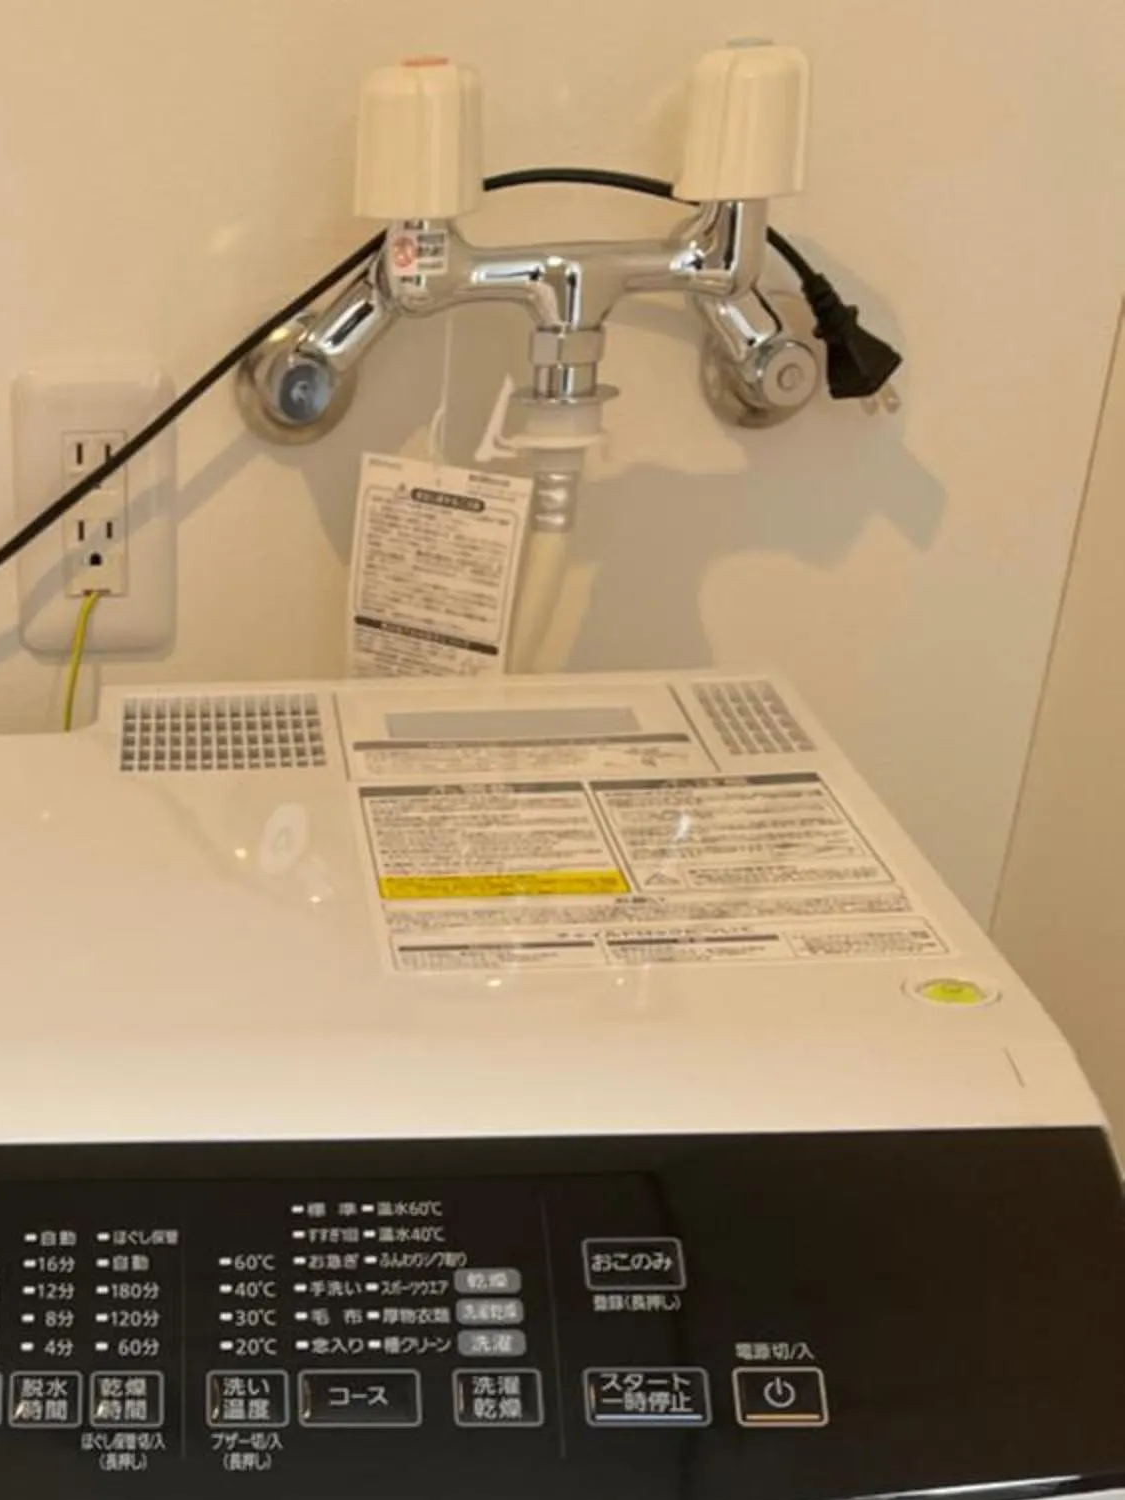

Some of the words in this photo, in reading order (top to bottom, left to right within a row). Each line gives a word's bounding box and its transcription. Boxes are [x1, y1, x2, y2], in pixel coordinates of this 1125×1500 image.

[38, 1257, 76, 1274] 16分
[590, 1252, 674, 1273] おこのみ
[38, 1284, 75, 1301] 12分
[111, 1283, 160, 1300] 180分
[310, 1279, 362, 1297] 手洗い
[44, 1310, 75, 1328] 8分
[111, 1310, 160, 1328] 120分
[43, 1339, 74, 1357] 4分
[117, 1339, 160, 1356] 60分
[22, 1377, 68, 1398] 脱水
[99, 1377, 147, 1398] 乾燥
[223, 1376, 271, 1397] 洗い
[472, 1375, 522, 1397] 洗濯
[600, 1372, 693, 1393] スタート
[328, 1385, 389, 1407] コース
[601, 1391, 694, 1414] 一時停止
[20, 1400, 68, 1421] 時間
[100, 1400, 147, 1421] 時間
[222, 1398, 271, 1421] 温度
[474, 1397, 523, 1420] 乾燥
